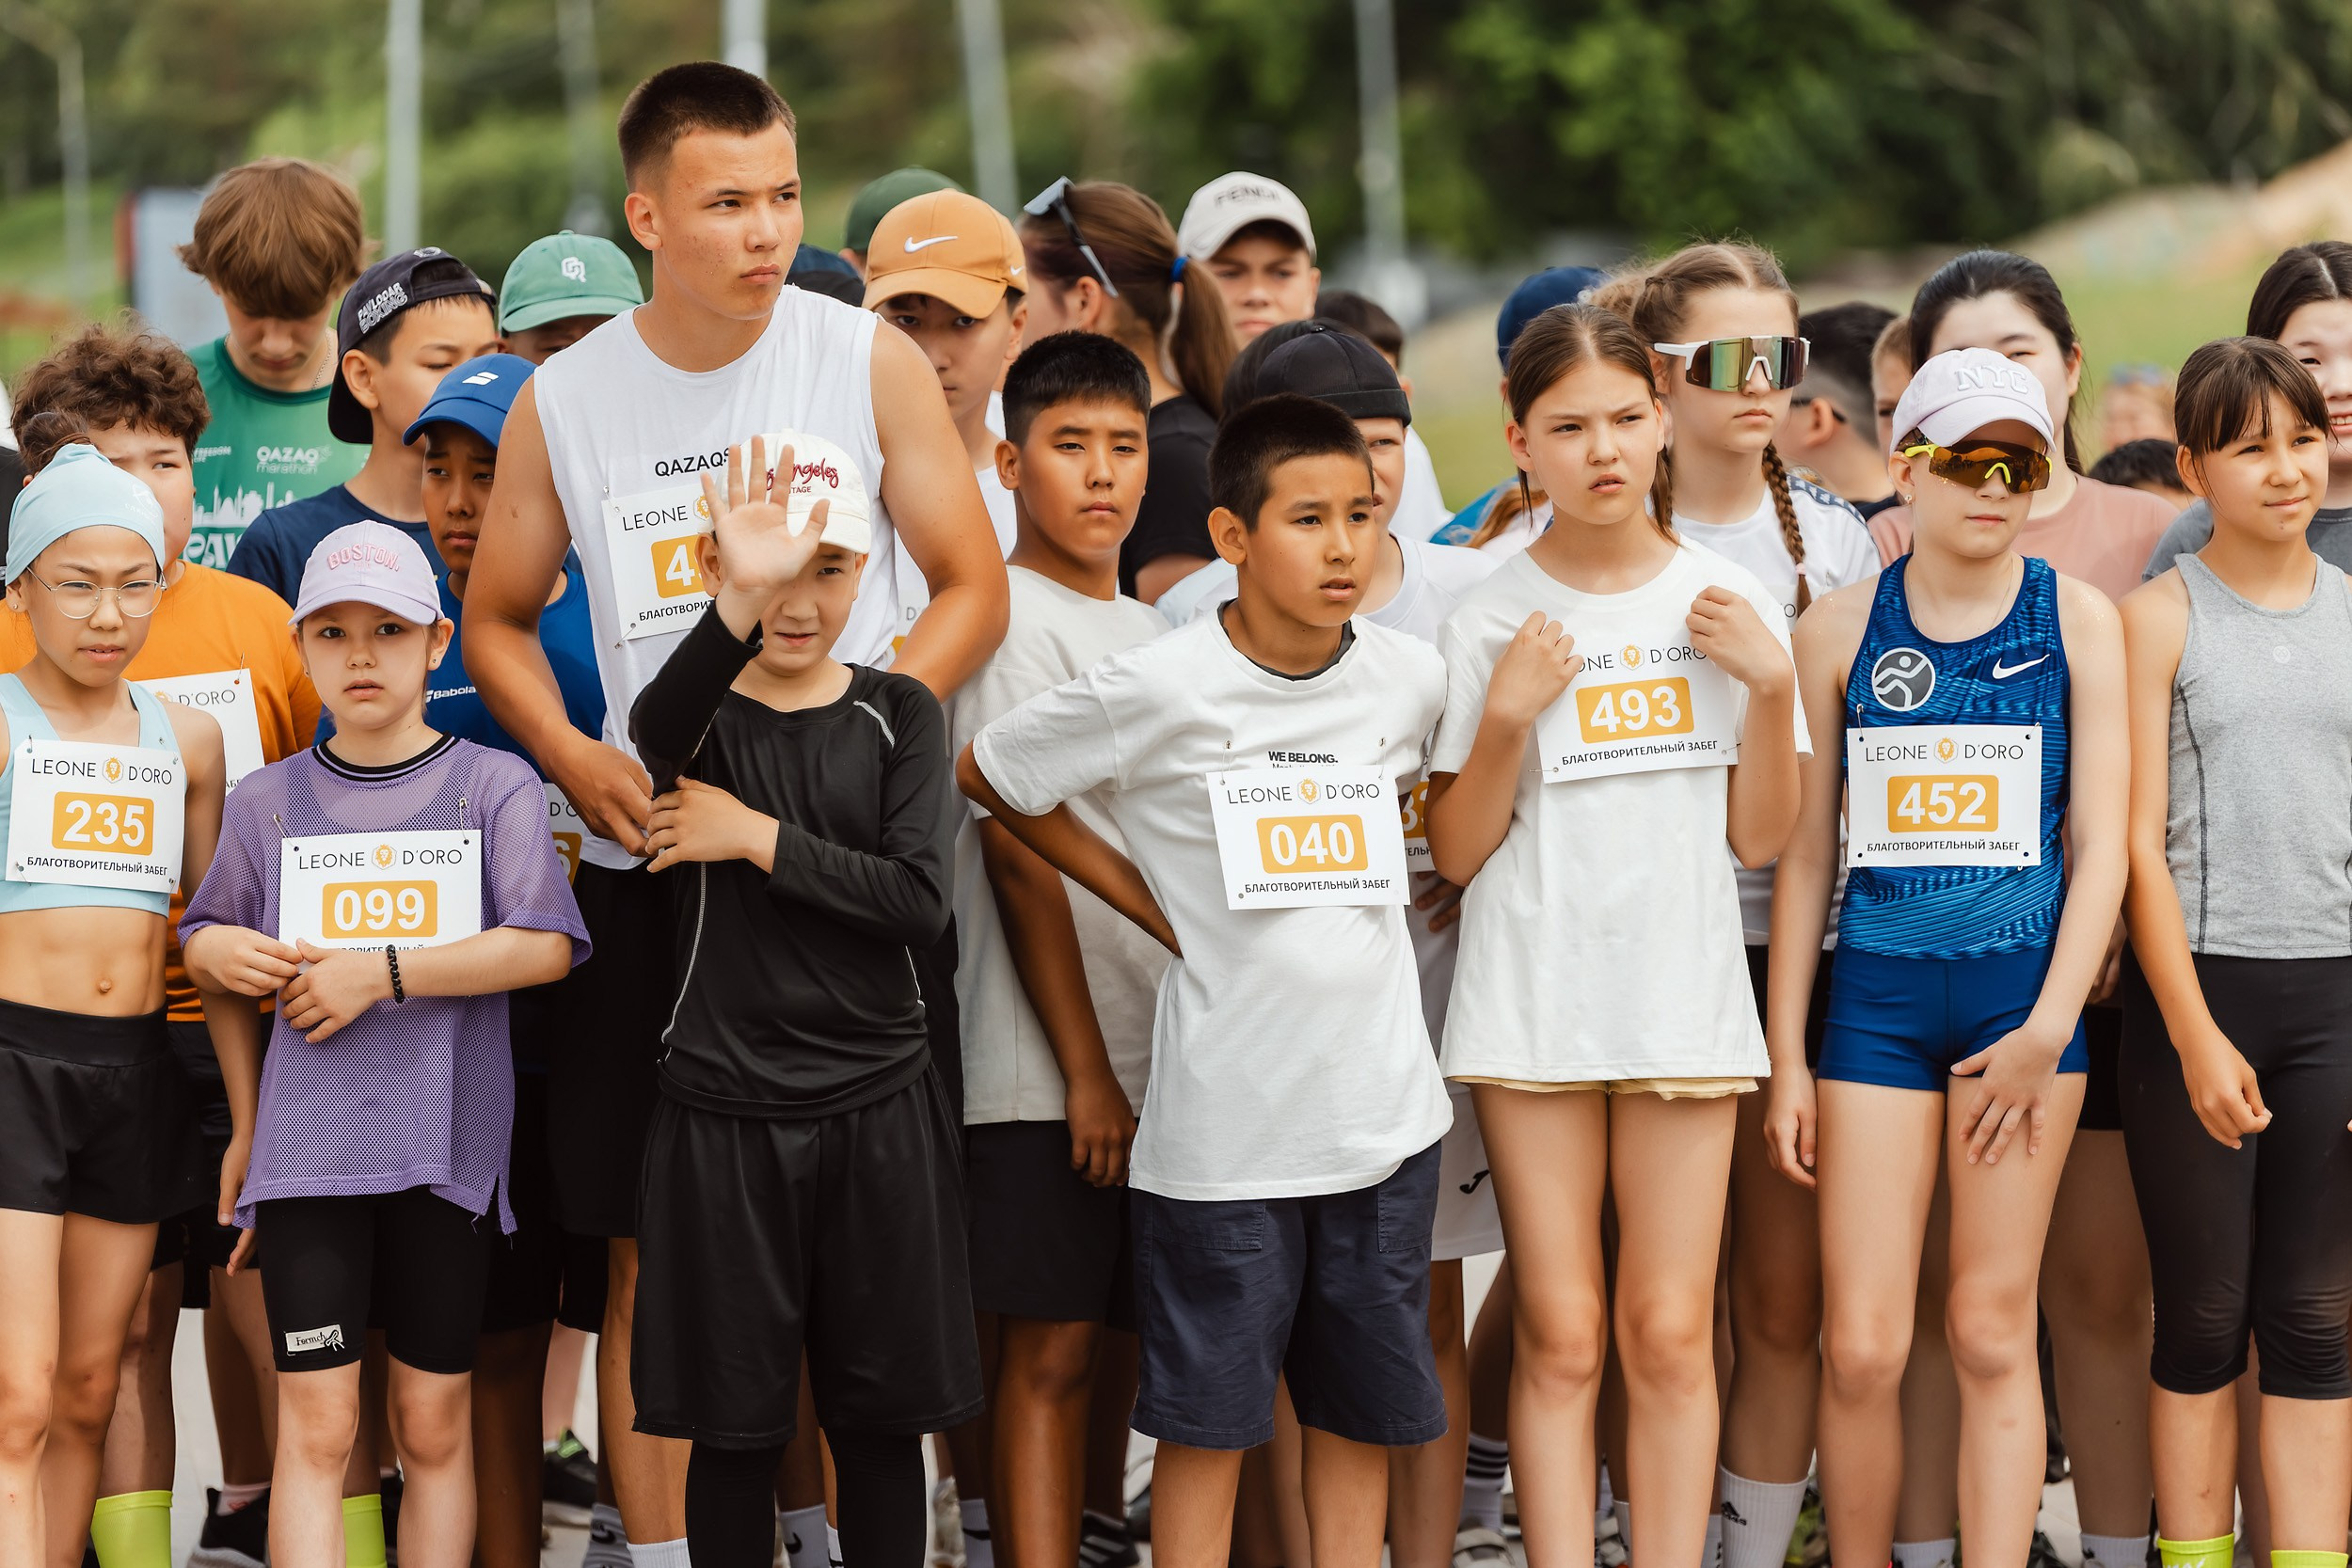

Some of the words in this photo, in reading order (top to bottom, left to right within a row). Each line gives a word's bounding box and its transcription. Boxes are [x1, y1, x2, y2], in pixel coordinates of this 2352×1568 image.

[358, 282, 405, 321] PAVLODAR
[359, 294, 408, 334] BOXING
[1954, 365, 2028, 395] NYC
[257, 446, 320, 465] QAZAQ
[257, 461, 318, 475] marathon
[791, 457, 839, 489] ngeles
[789, 485, 812, 494] TAGE
[622, 505, 689, 531] LEONE
[639, 599, 715, 622] БЛАГОТВОРИ
[433, 686, 476, 700] Babola
[1590, 685, 1681, 734] 493
[1267, 751, 1286, 762] WE
[1288, 752, 1339, 764] BELONG.
[1562, 740, 1685, 766] БЛАГОТВОРИТЕЛЬНЫЙ
[1688, 740, 1718, 752] ЗАБЕГ
[1866, 745, 1928, 762] LEONE
[1964, 744, 2024, 760] D'ORO
[31, 758, 97, 778] LEONE
[128, 766, 173, 785] D'ORO
[1227, 785, 1293, 804] LEONE
[1326, 784, 1380, 800] D'ORO
[1897, 782, 1987, 825] 452
[62, 800, 146, 847] 235
[1270, 821, 1355, 866] 040
[1867, 839, 1986, 852] БЛАГОТВОРИТЕЛЬНЫЙ
[1988, 841, 2021, 851] ЗАБЕГ
[26, 856, 143, 873] БЛАГОТВОРИТЕЛЬНЫЙ
[144, 864, 168, 876] ЗАБЕГ
[299, 851, 365, 870] LEONE
[403, 848, 463, 865] D'ORO
[1245, 879, 1360, 894] БЛАГОТВОРИТЕЛЬНЫЙ
[1361, 879, 1391, 889] ЗАБЕГ
[333, 887, 425, 931] 099
